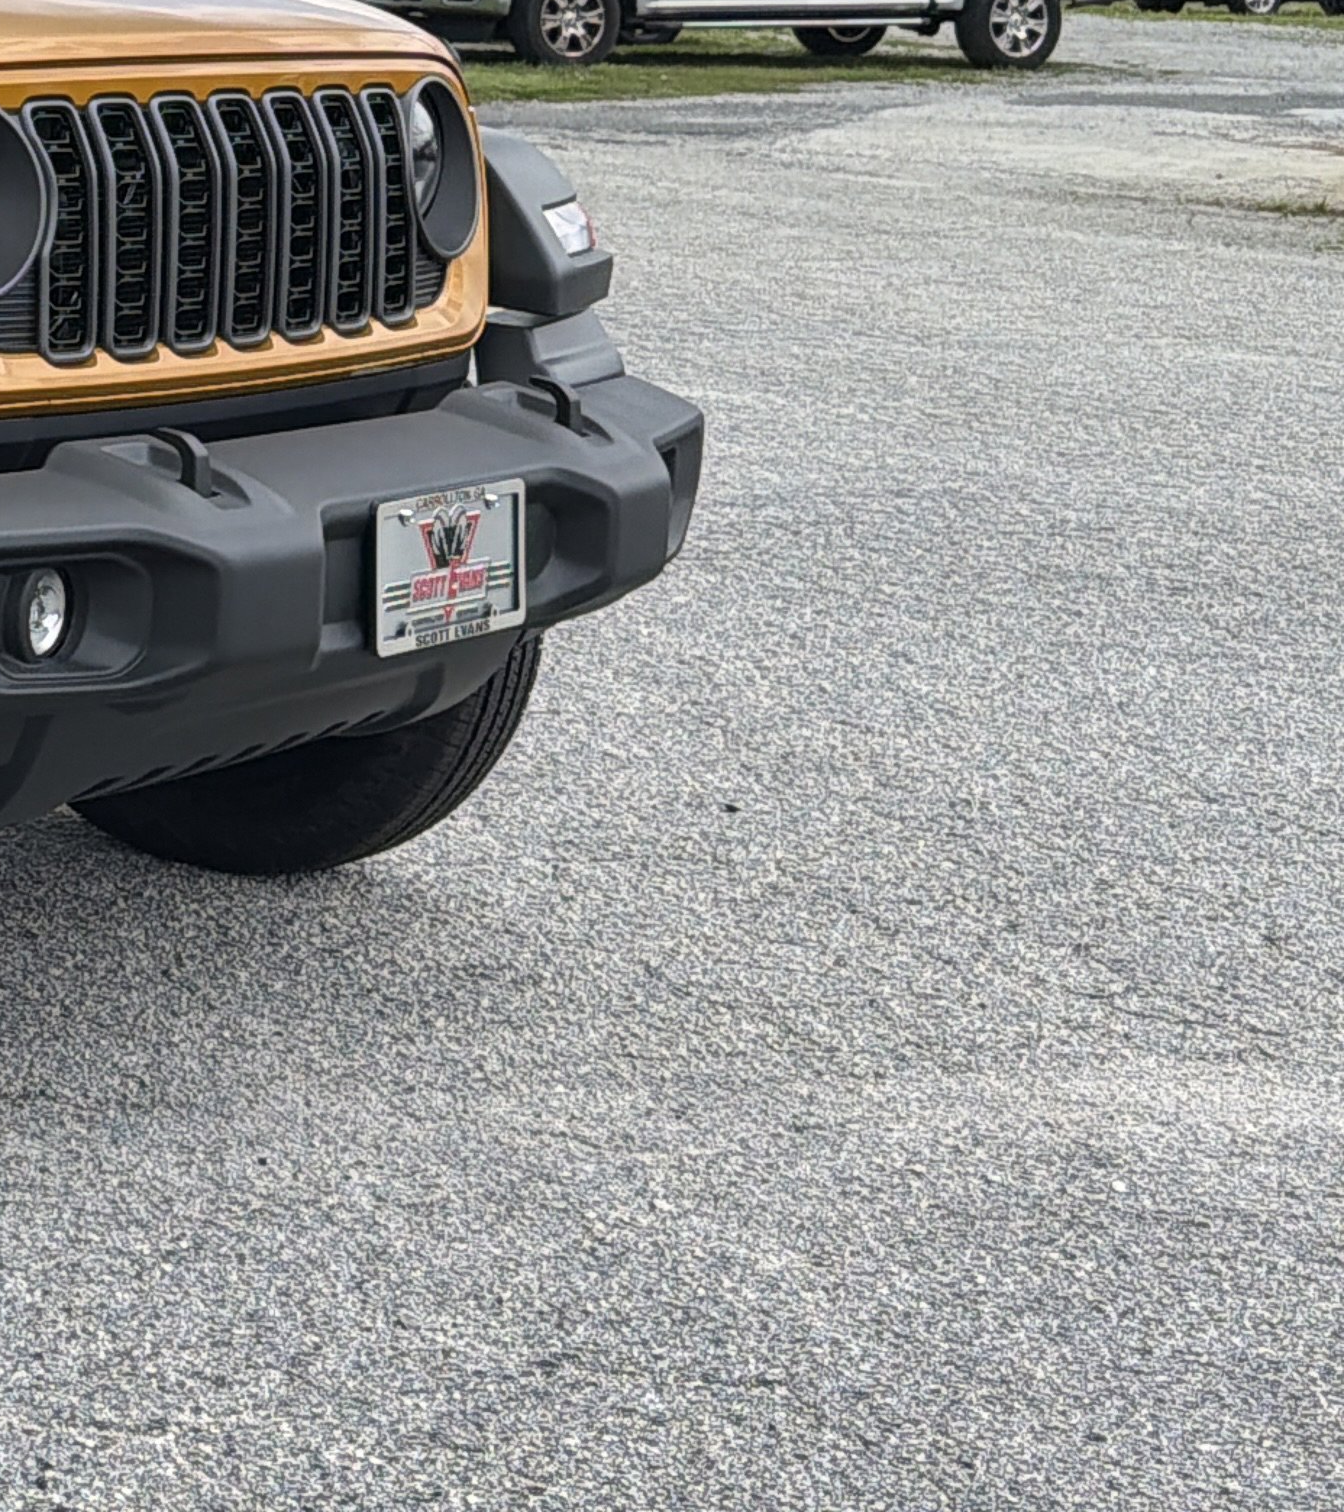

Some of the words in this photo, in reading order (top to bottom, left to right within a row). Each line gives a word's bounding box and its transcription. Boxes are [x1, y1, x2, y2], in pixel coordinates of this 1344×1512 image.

[413, 575, 447, 602] SCOTT
[415, 629, 450, 647] SCOTT
[454, 619, 490, 638] EVANS
